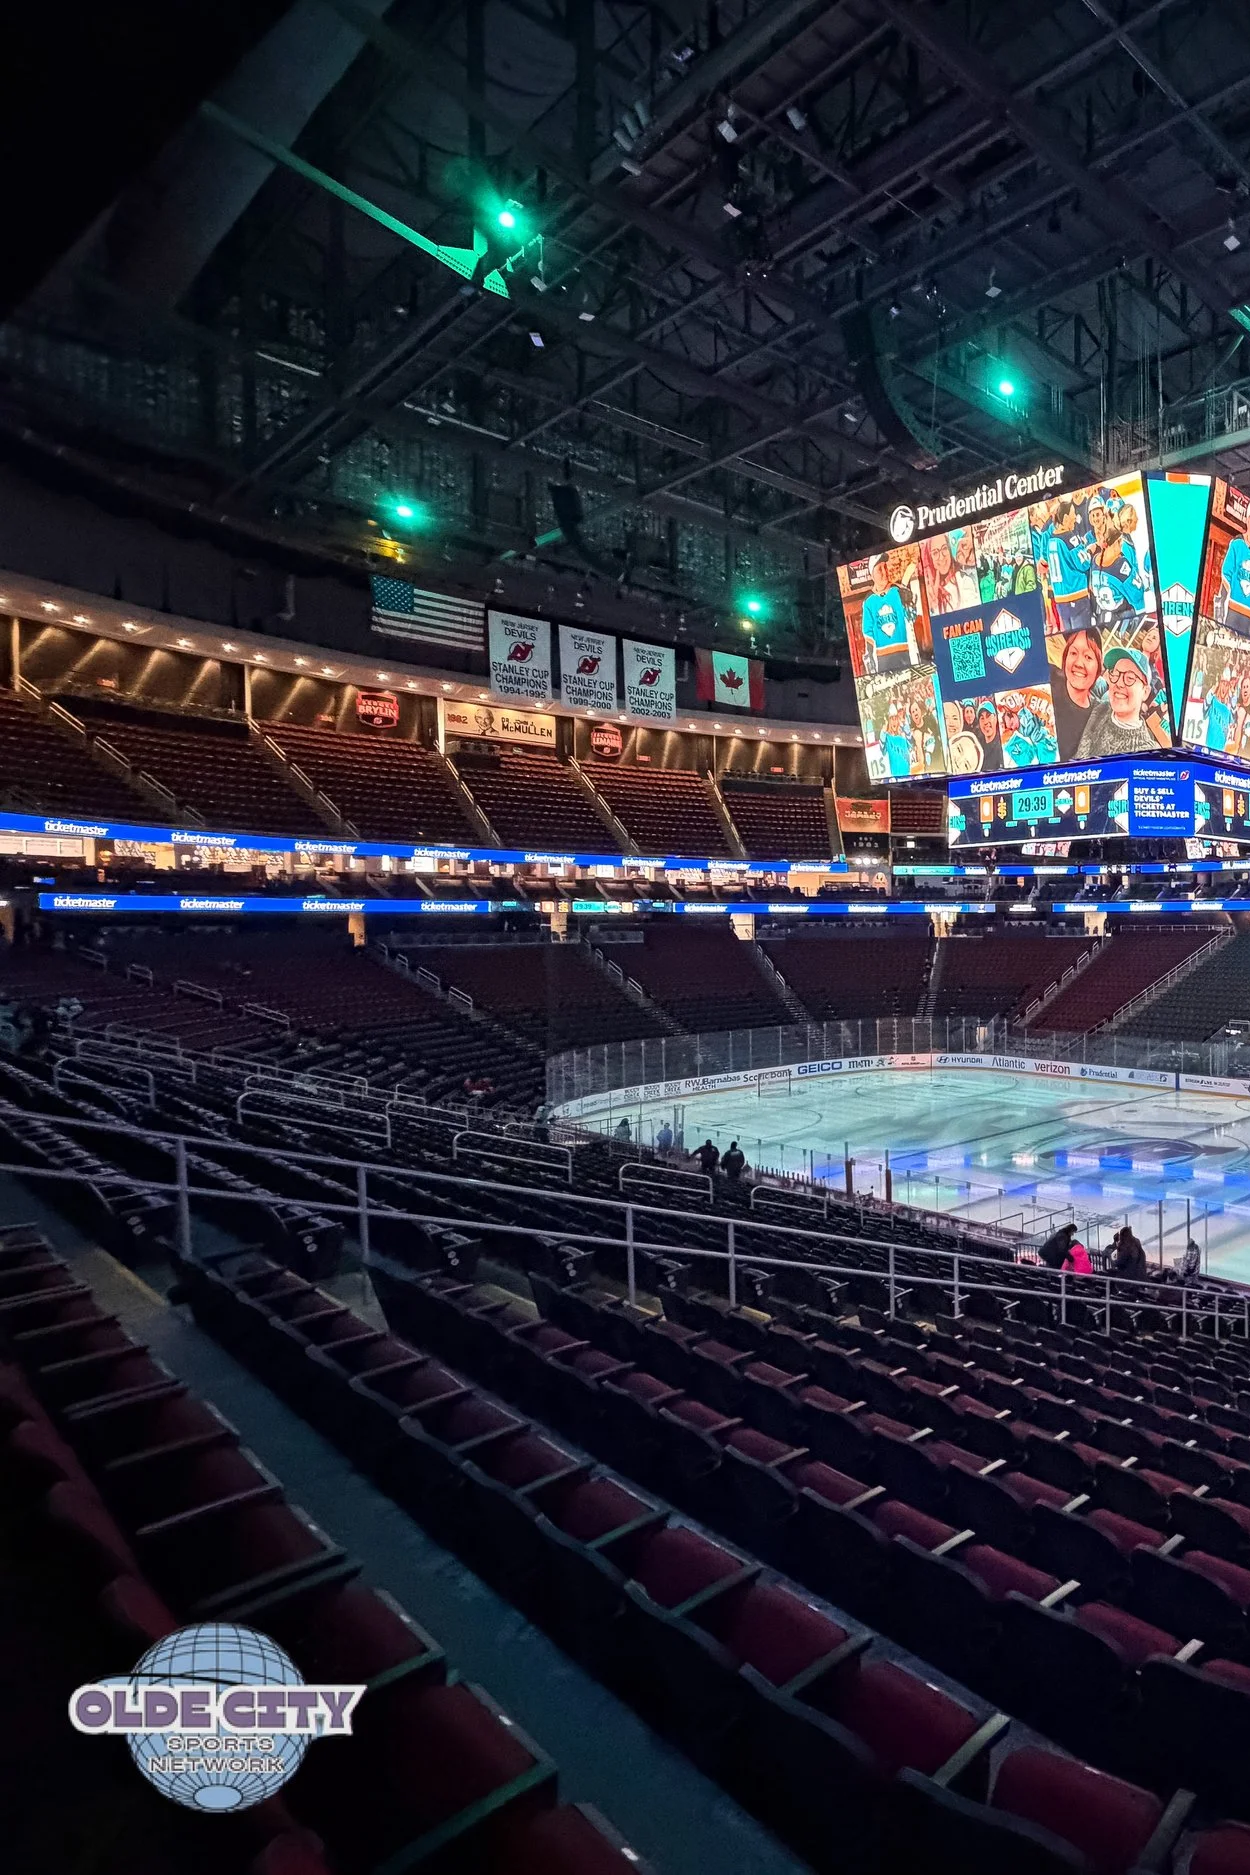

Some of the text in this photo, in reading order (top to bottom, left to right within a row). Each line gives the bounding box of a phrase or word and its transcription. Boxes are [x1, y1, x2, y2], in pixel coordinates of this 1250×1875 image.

[917, 464, 1064, 530] Prudential Center
[504, 627, 537, 641] DEVILS
[943, 618, 983, 639] FAN CAM
[574, 641, 603, 655] DEVILS
[989, 627, 1028, 656] SIRENS
[636, 654, 663, 667] DEVILS
[492, 661, 549, 679] STANLEY CUP
[495, 673, 548, 691] CHAMPIONS
[563, 673, 615, 692] STANLEY CUP
[499, 685, 546, 699] 1994-1995
[565, 685, 614, 702] CHAMPIONS
[627, 686, 675, 702] STANLEY CUP
[569, 696, 612, 710] 1999-2000
[629, 696, 673, 712] CHAMPIONS
[358, 705, 397, 717] BRYLIN
[631, 707, 672, 719] 2002-2003
[501, 723, 553, 738] McMULLEN
[1043, 769, 1102, 785] ticketmaster
[970, 778, 1023, 793] ticketmaster
[1018, 795, 1047, 812] 29:39
[44, 820, 109, 836] ticketmaster
[171, 832, 236, 847] ticketmaster
[294, 841, 357, 853] ticketmaster
[414, 848, 470, 860] ticketmaster
[525, 854, 575, 865] ticketmaster
[53, 896, 117, 909] ticketmaster
[180, 899, 244, 911] ticketmaster
[302, 900, 365, 912] ticketmaster
[421, 902, 477, 912] ticketmaster
[951, 1056, 983, 1064] HYUNDAI
[992, 1056, 1025, 1070] Atlantic
[797, 1061, 843, 1075] GEICO
[1034, 1062, 1070, 1075] verizon
[1088, 1068, 1118, 1079] Prudential
